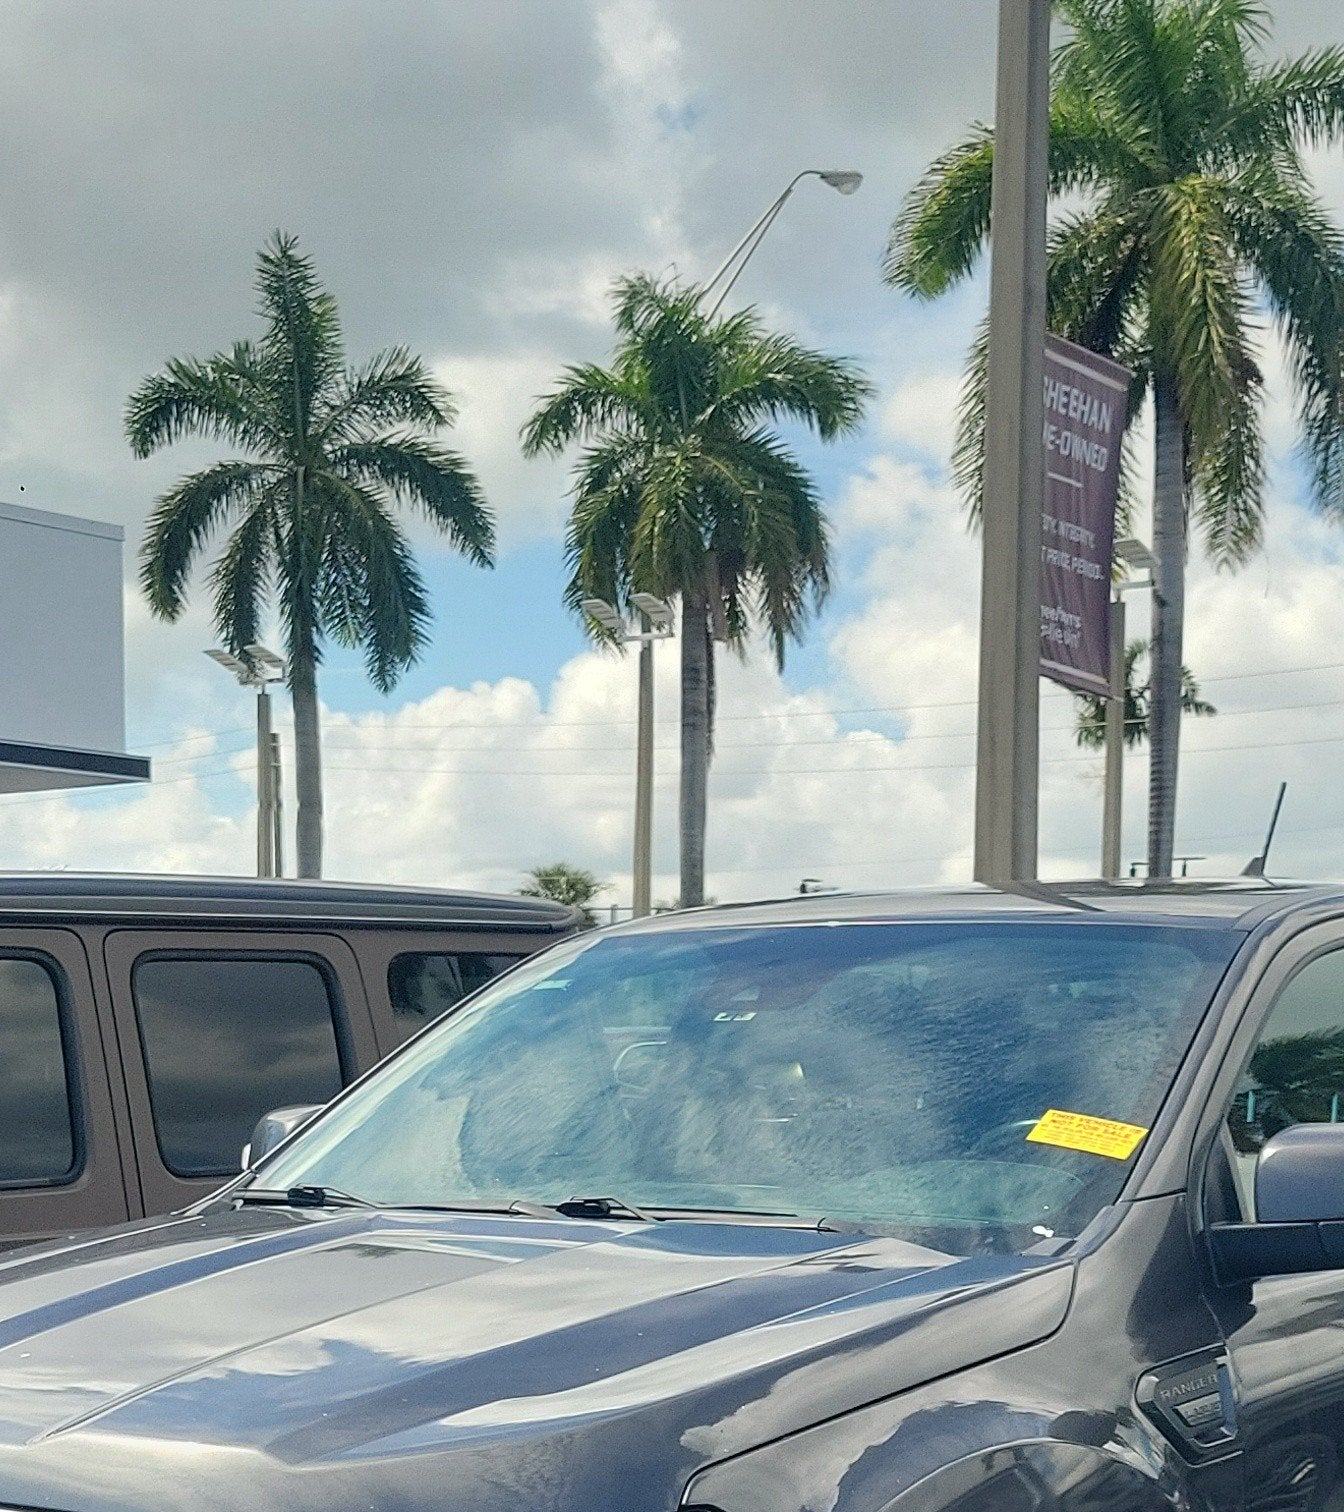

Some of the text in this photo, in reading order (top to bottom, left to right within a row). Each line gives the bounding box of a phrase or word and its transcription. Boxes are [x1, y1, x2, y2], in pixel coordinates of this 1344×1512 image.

[1043, 421, 1108, 472] E-OWNED
[1079, 1116, 1127, 1130] VEHICLE
[1160, 1373, 1218, 1399] RANGER
